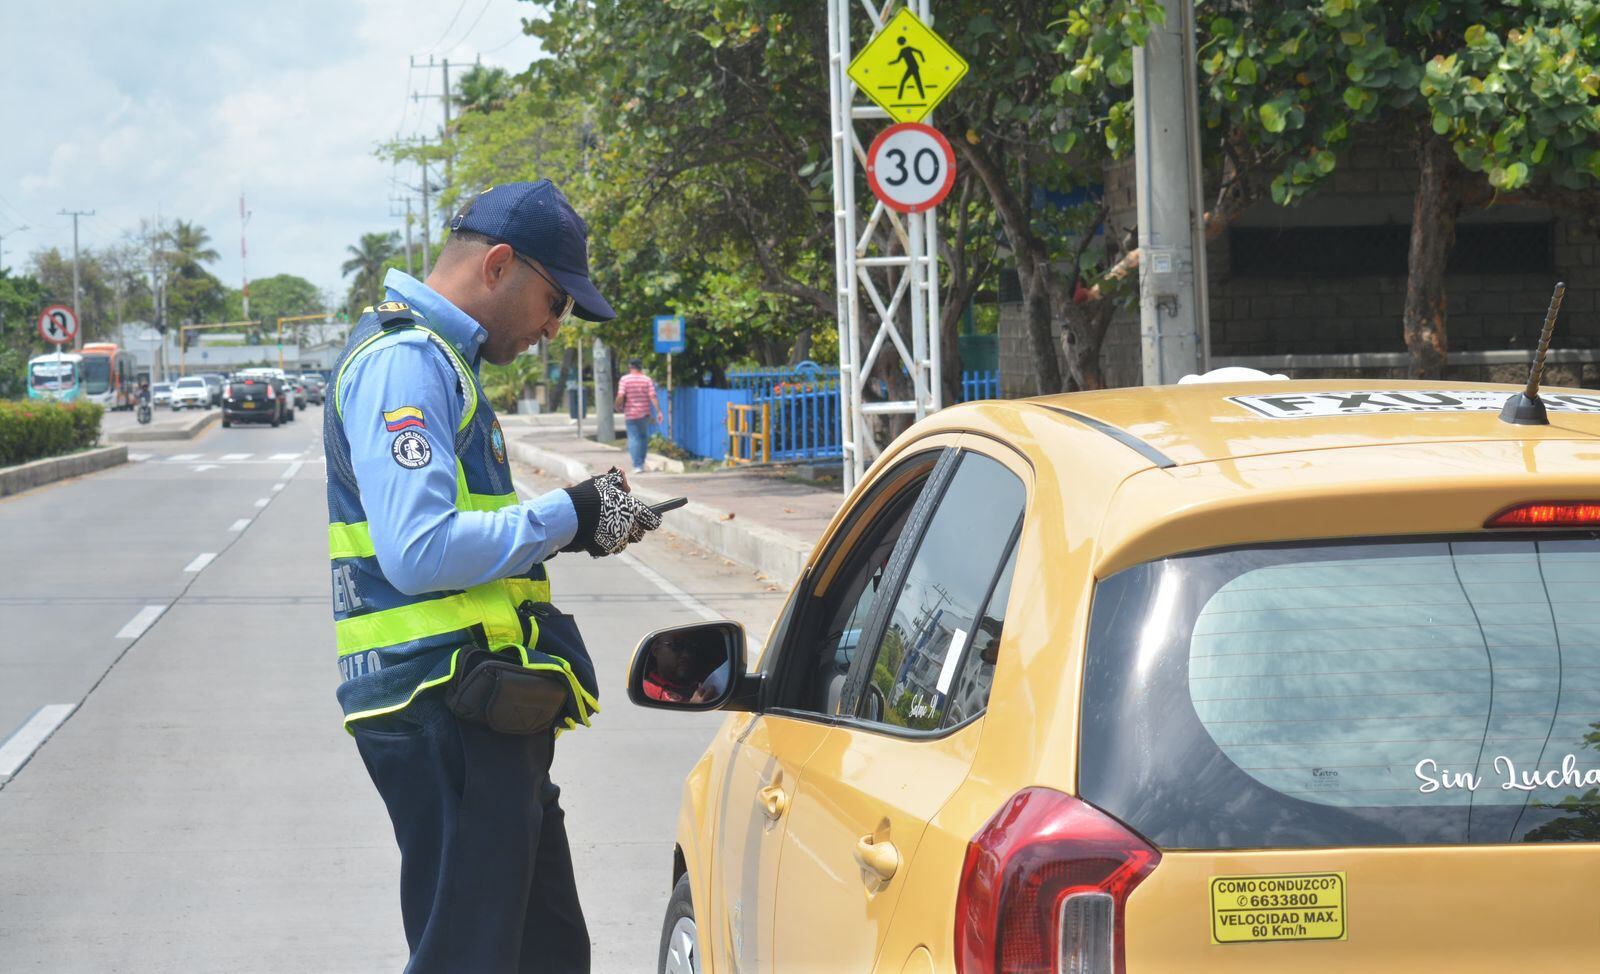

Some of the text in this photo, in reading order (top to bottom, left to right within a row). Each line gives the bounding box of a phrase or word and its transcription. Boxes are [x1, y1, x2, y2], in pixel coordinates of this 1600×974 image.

[885, 148, 939, 186] 30
[1258, 393, 1463, 412] FXU
[1414, 758, 1482, 793] Sin
[1218, 878, 1337, 893] COMO CONDUZCO?
[1250, 893, 1318, 907] 6633800
[1220, 911, 1338, 926] VELOCIDAD MAX.
[1252, 924, 1307, 937] 60 Km/h
